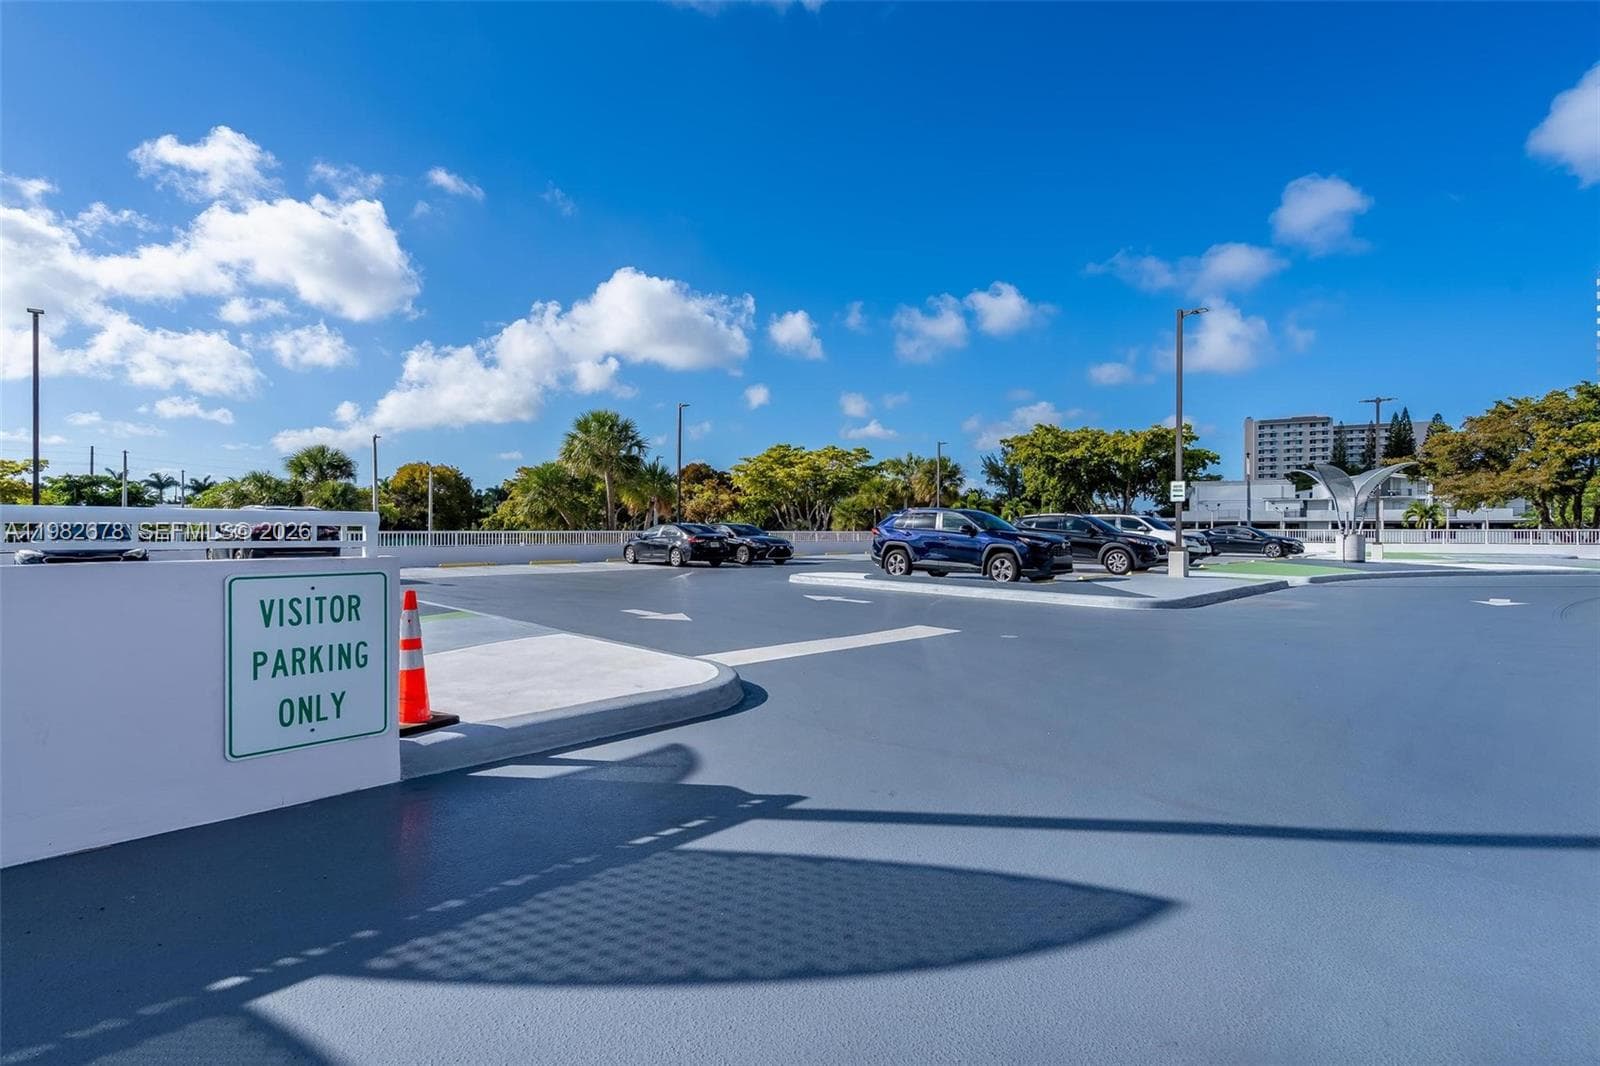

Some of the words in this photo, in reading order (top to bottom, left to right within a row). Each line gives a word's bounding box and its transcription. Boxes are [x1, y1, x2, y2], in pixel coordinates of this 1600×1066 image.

[259, 594, 361, 628] VISITOR
[252, 641, 368, 681] PARKING
[278, 690, 346, 727] ONLY
